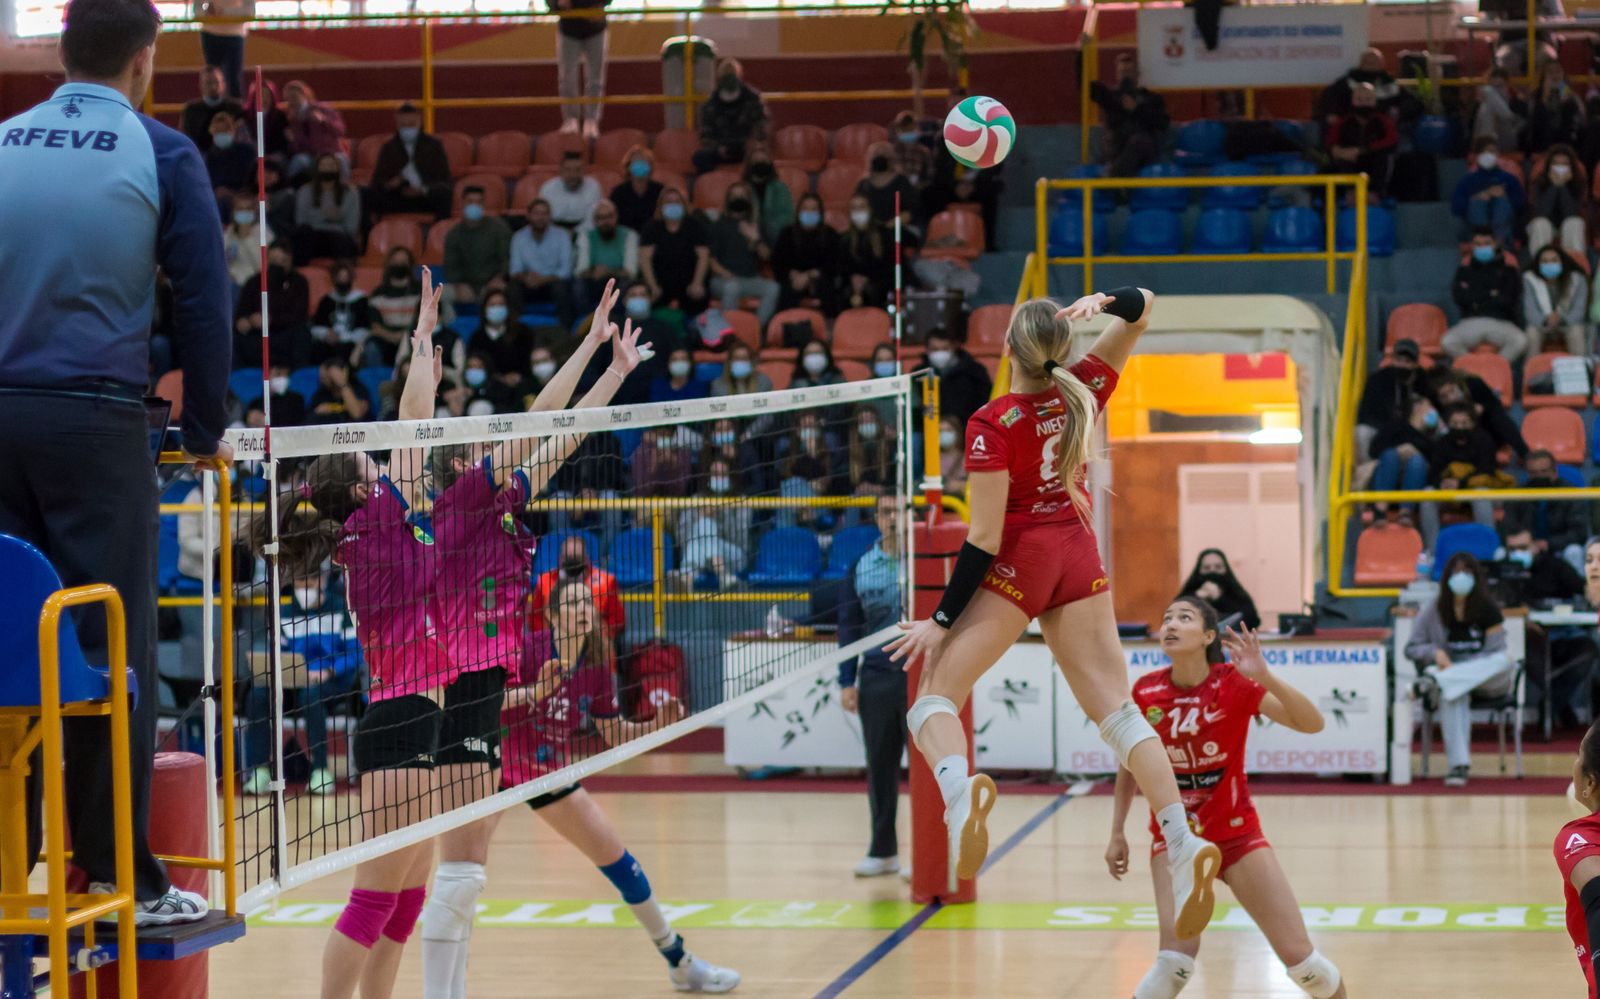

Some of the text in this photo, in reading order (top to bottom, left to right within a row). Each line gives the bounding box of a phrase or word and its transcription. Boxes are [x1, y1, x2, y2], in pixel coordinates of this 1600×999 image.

[1, 127, 119, 152] RFEVB
[331, 427, 366, 445] rfevb.com
[985, 573, 1025, 601] ivisa
[1263, 650, 1288, 664] OS
[1293, 648, 1380, 665] HERMANAS
[1167, 707, 1200, 739] 14
[1071, 750, 1378, 769] DEL DEPORTES
